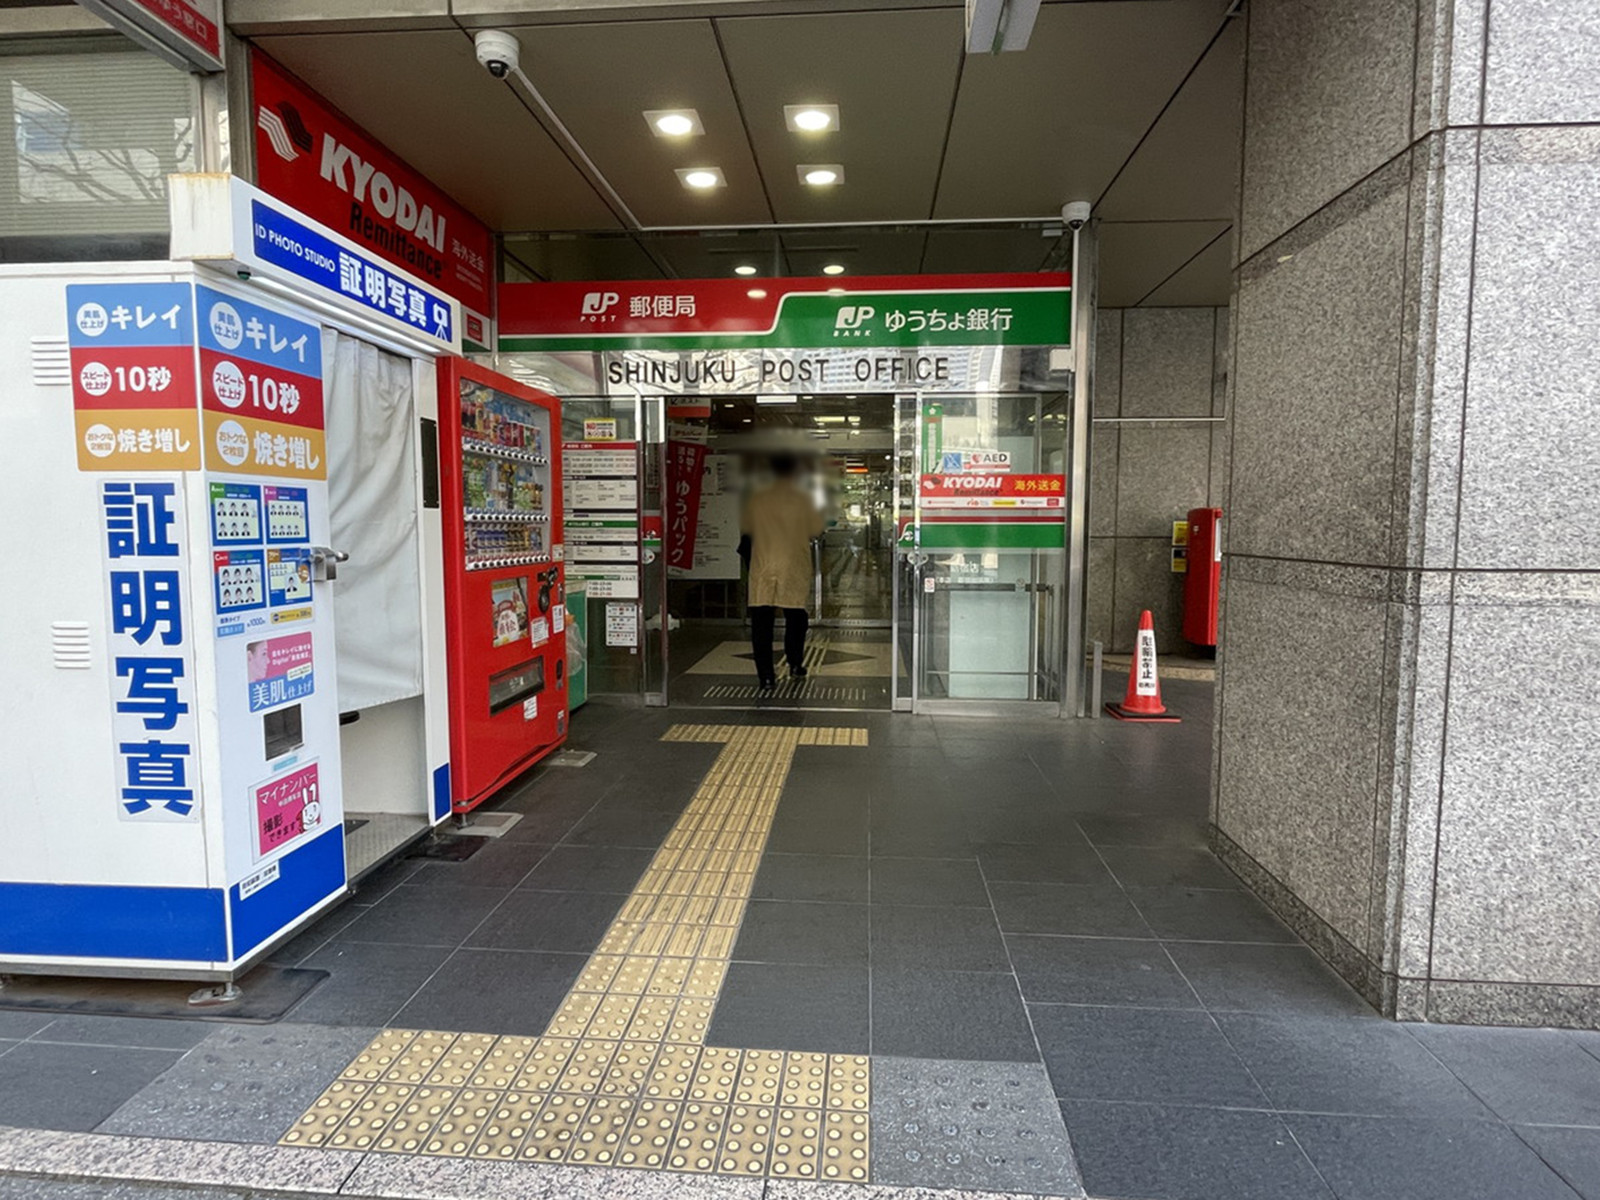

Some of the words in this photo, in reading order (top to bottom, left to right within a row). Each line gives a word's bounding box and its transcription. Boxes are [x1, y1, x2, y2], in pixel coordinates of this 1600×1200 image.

[320, 132, 446, 253] KYODAI
[255, 223, 266, 239] ID
[269, 230, 303, 257] PHOTO
[304, 247, 336, 273] STUDIO
[349, 201, 443, 279] Remittance
[339, 250, 428, 328] 証明写真
[111, 304, 181, 330] キレイ
[629, 295, 697, 317] 郵便局
[885, 308, 1013, 332] ゆうちょ銀行
[245, 316, 309, 363] キレイ
[114, 366, 172, 392] 10秒
[608, 360, 736, 384] SHINJUKU
[762, 358, 830, 382] POST
[854, 357, 950, 381] OFFICE
[85, 381, 108, 390] 仕上げ
[218, 386, 242, 401] 仕上げ
[248, 374, 300, 415] 10秒
[117, 428, 191, 454] 焼き増し
[219, 431, 247, 445] おトクな
[253, 430, 320, 470] 焼き増し
[983, 453, 1008, 463] AED
[943, 477, 1003, 488] KYODAI
[1014, 479, 1061, 491] 海外送金
[671, 480, 691, 563] ゆうパック
[103, 482, 194, 816] 証明写真
[259, 773, 316, 804] マイナンバー
[268, 821, 296, 842] できます
